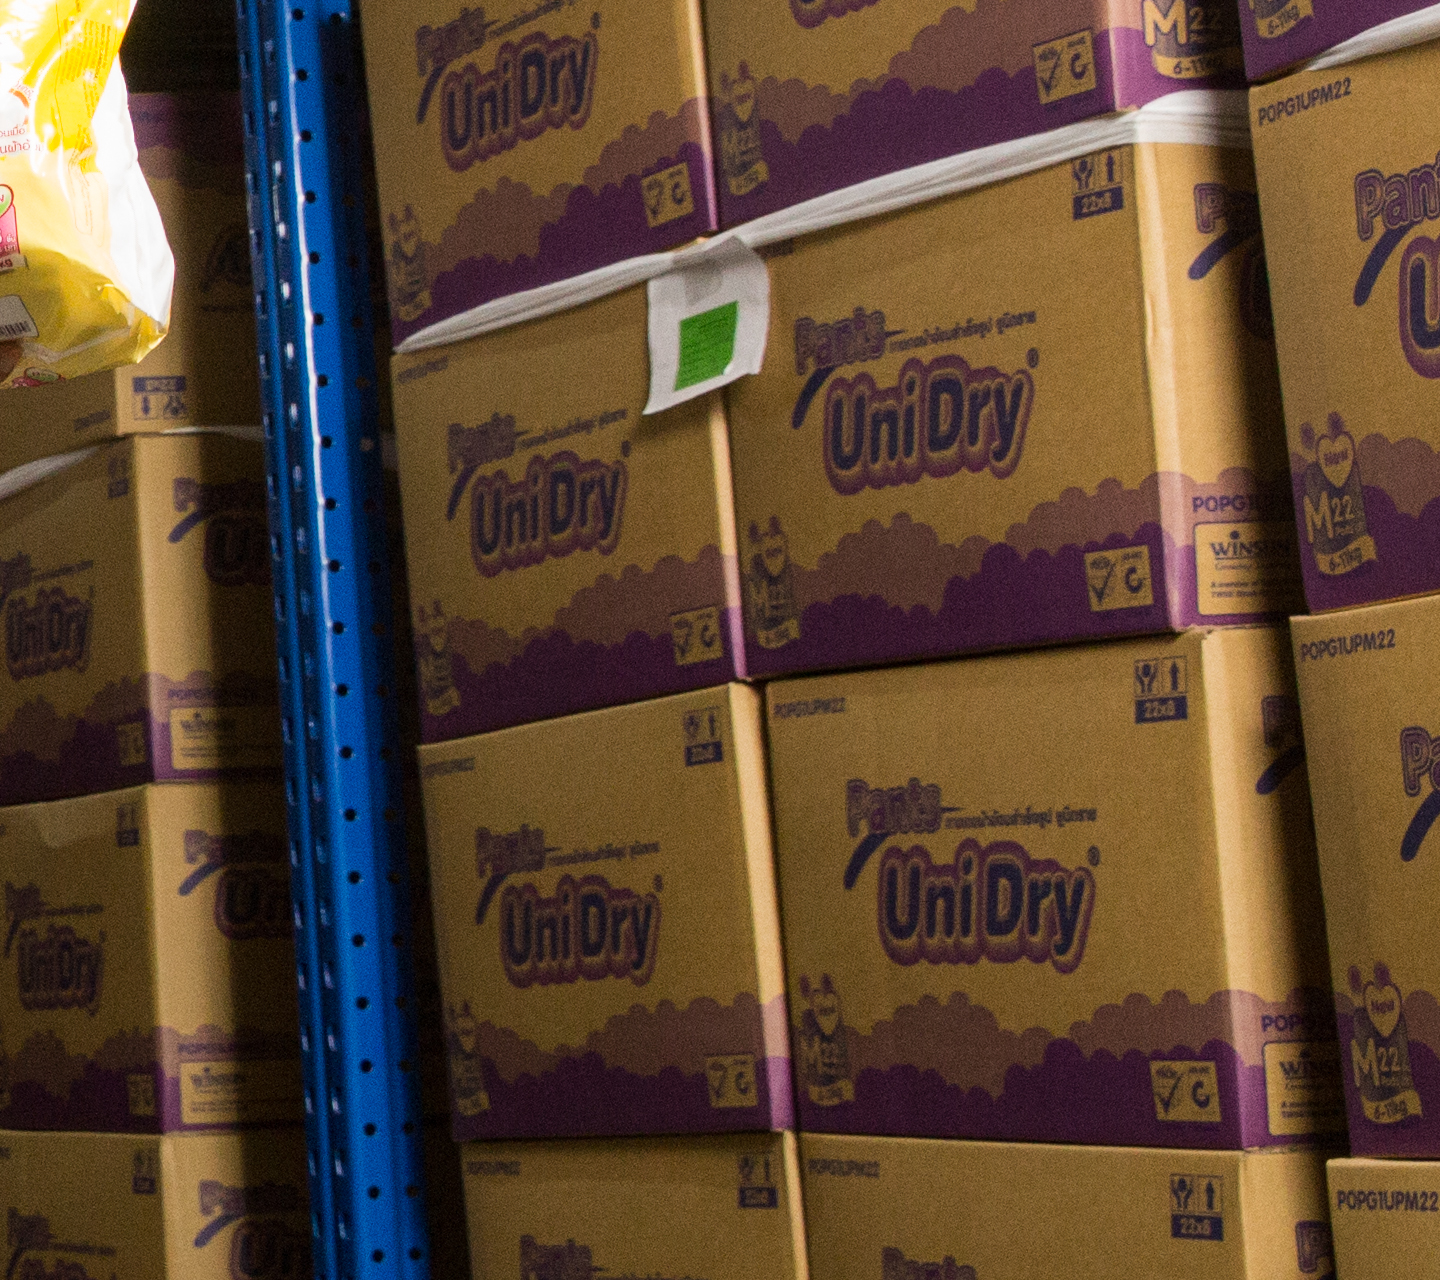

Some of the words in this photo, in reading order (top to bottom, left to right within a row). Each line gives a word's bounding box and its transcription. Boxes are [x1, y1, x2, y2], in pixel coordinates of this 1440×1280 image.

[1258, 77, 1352, 128] POPG1UPM22
[1300, 629, 1396, 662] POPG1UPM22
[1337, 1190, 1439, 1212] POPG1UPM22
